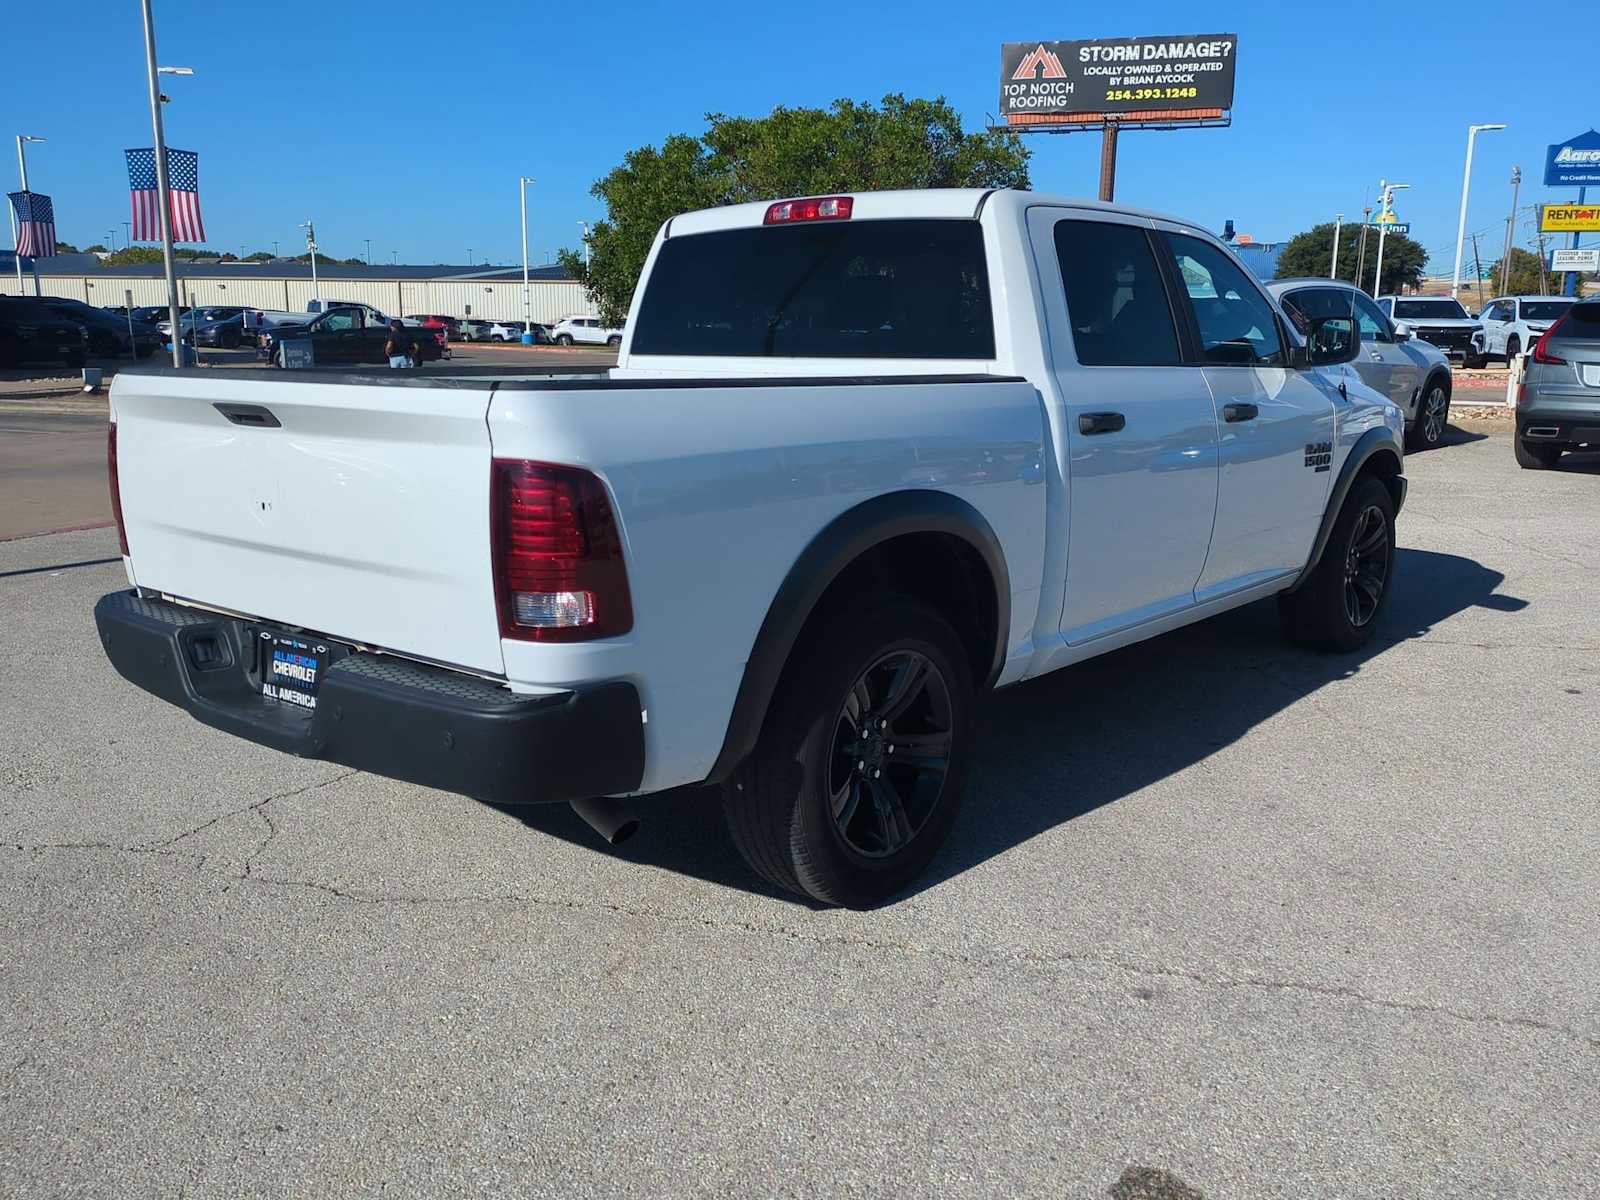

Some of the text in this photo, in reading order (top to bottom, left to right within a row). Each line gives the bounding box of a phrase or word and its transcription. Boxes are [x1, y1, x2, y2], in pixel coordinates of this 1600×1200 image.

[1079, 41, 1232, 62] STORM DAMAGE?
[1084, 62, 1223, 76] LOCALLY OWNED & OPERATED
[1110, 74, 1194, 86] BY BRIAN AYCOCK
[1004, 82, 1074, 96] TOP NOTCH
[1106, 87, 1197, 100] 254.393.1248
[1009, 95, 1067, 108] ROOFING
[1305, 441, 1332, 455] RAM
[1304, 454, 1331, 467] 1500
[273, 649, 317, 669] ALL AMERICAN
[273, 660, 316, 683] CHEVROLET
[263, 683, 316, 708] ALL AMERICA
